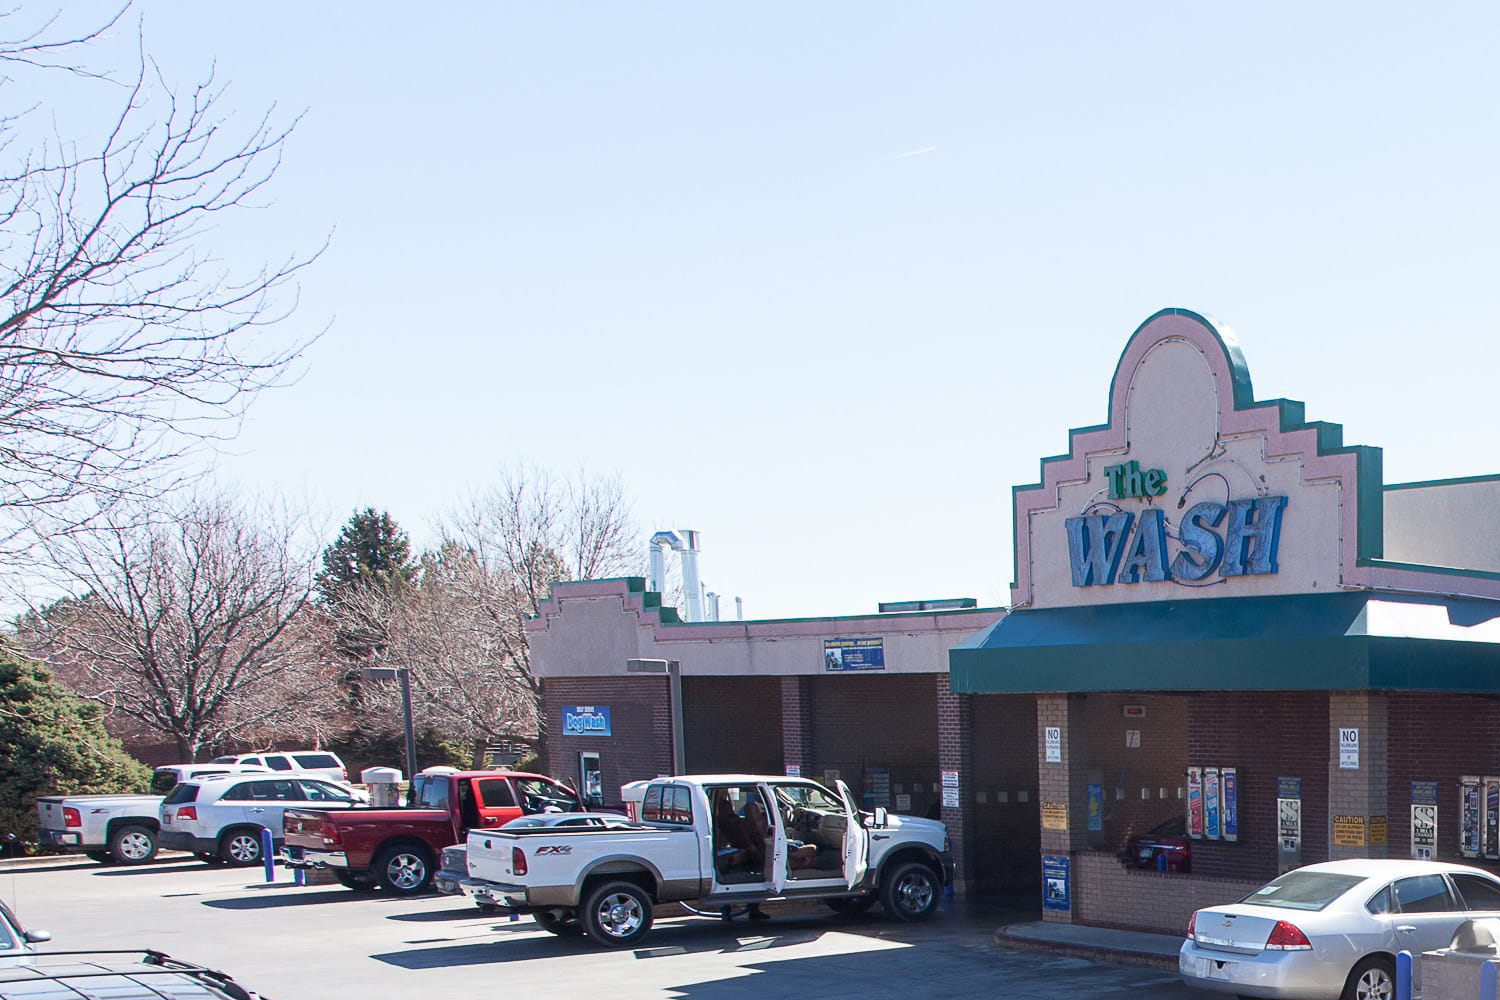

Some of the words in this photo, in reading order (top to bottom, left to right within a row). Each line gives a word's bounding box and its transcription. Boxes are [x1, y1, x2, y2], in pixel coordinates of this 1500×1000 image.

[1104, 460, 1168, 500] The
[1065, 496, 1288, 587] WASH
[566, 713, 583, 732] Dog
[583, 712, 605, 729] Wash
[1048, 729, 1058, 740] NO
[1342, 731, 1356, 742] NO
[535, 845, 573, 854] FX4
